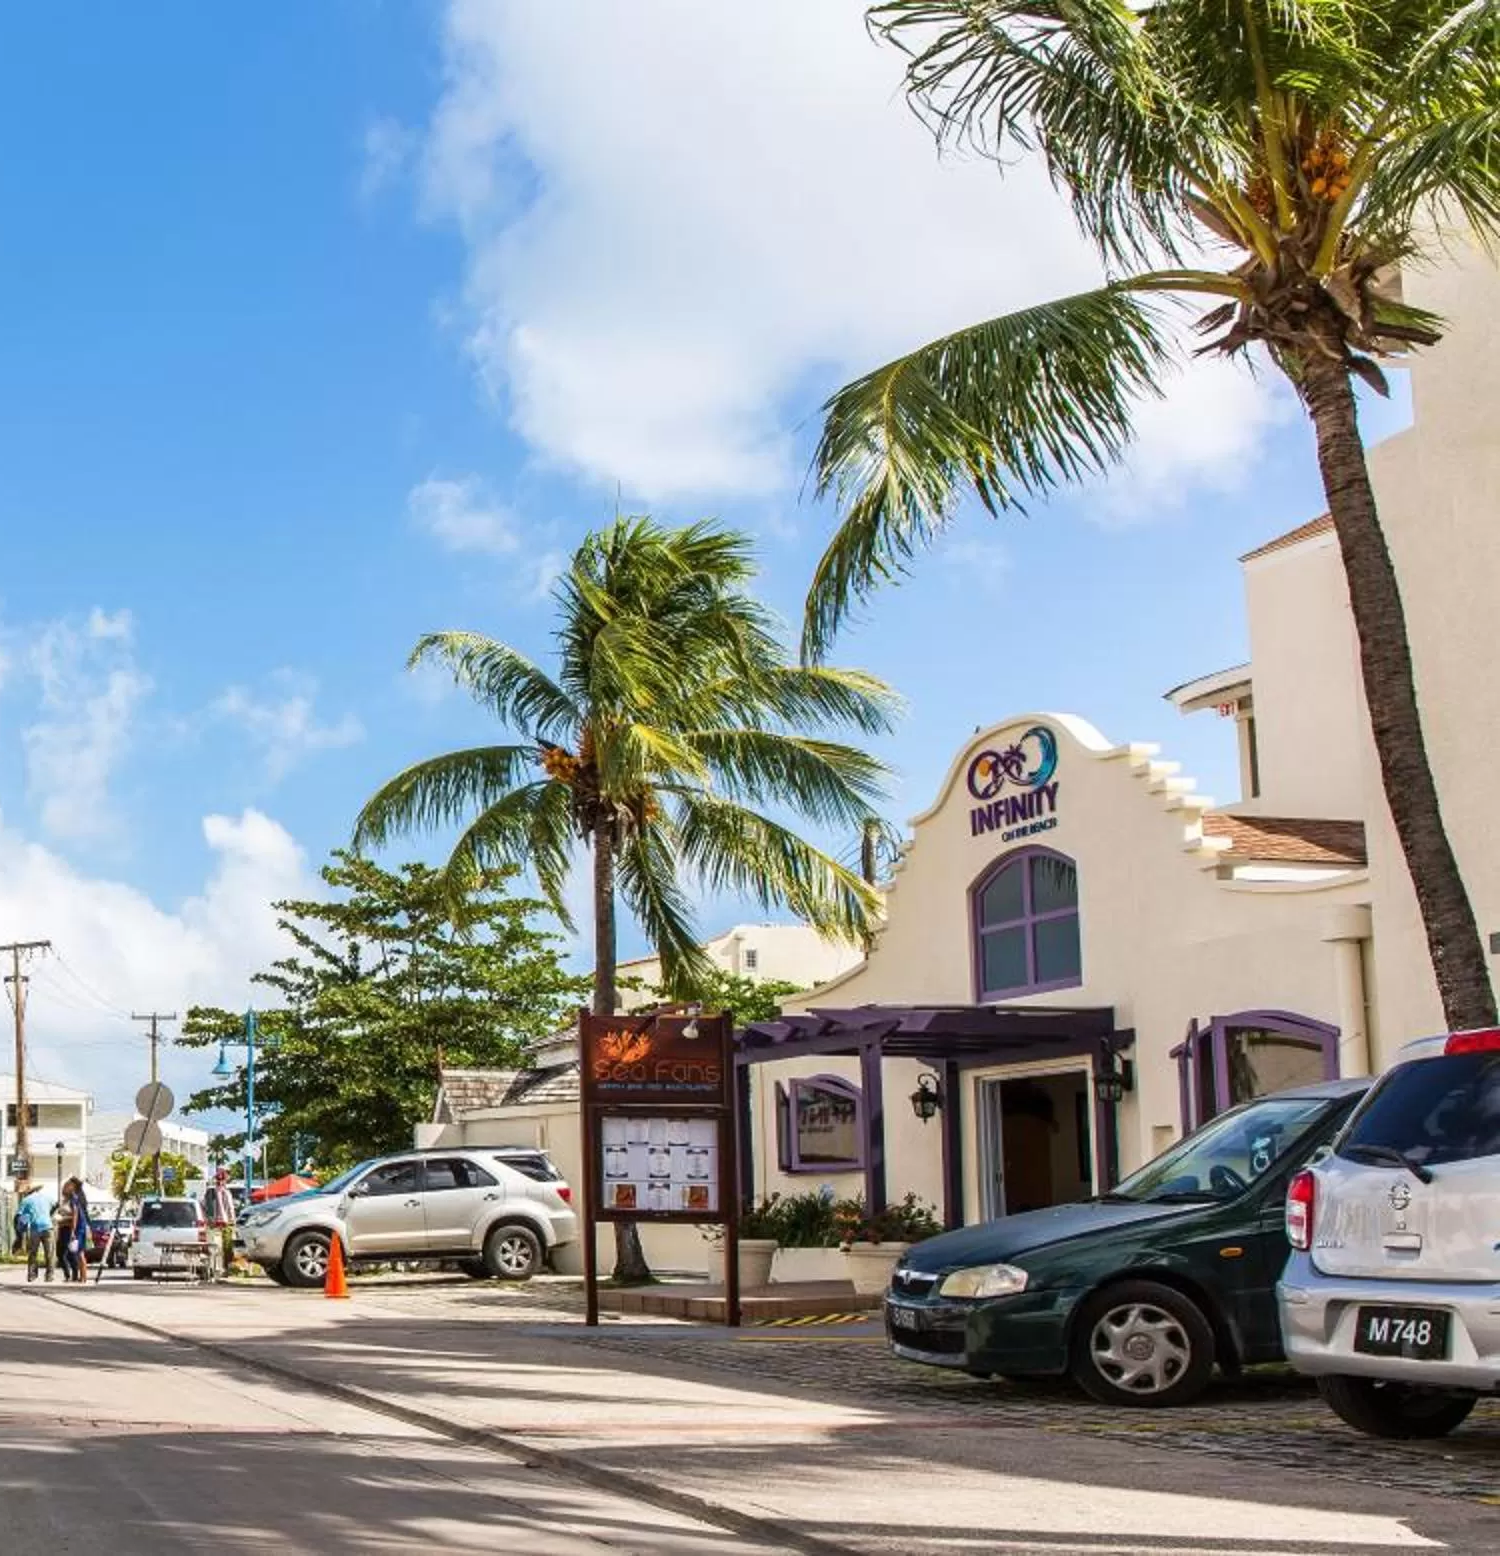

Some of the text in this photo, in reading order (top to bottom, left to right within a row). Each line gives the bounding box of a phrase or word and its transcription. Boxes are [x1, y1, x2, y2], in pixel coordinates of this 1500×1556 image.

[971, 782, 1059, 837] INFINITY
[594, 1059, 721, 1086] Sea Fans
[1368, 1317, 1432, 1346] M748
